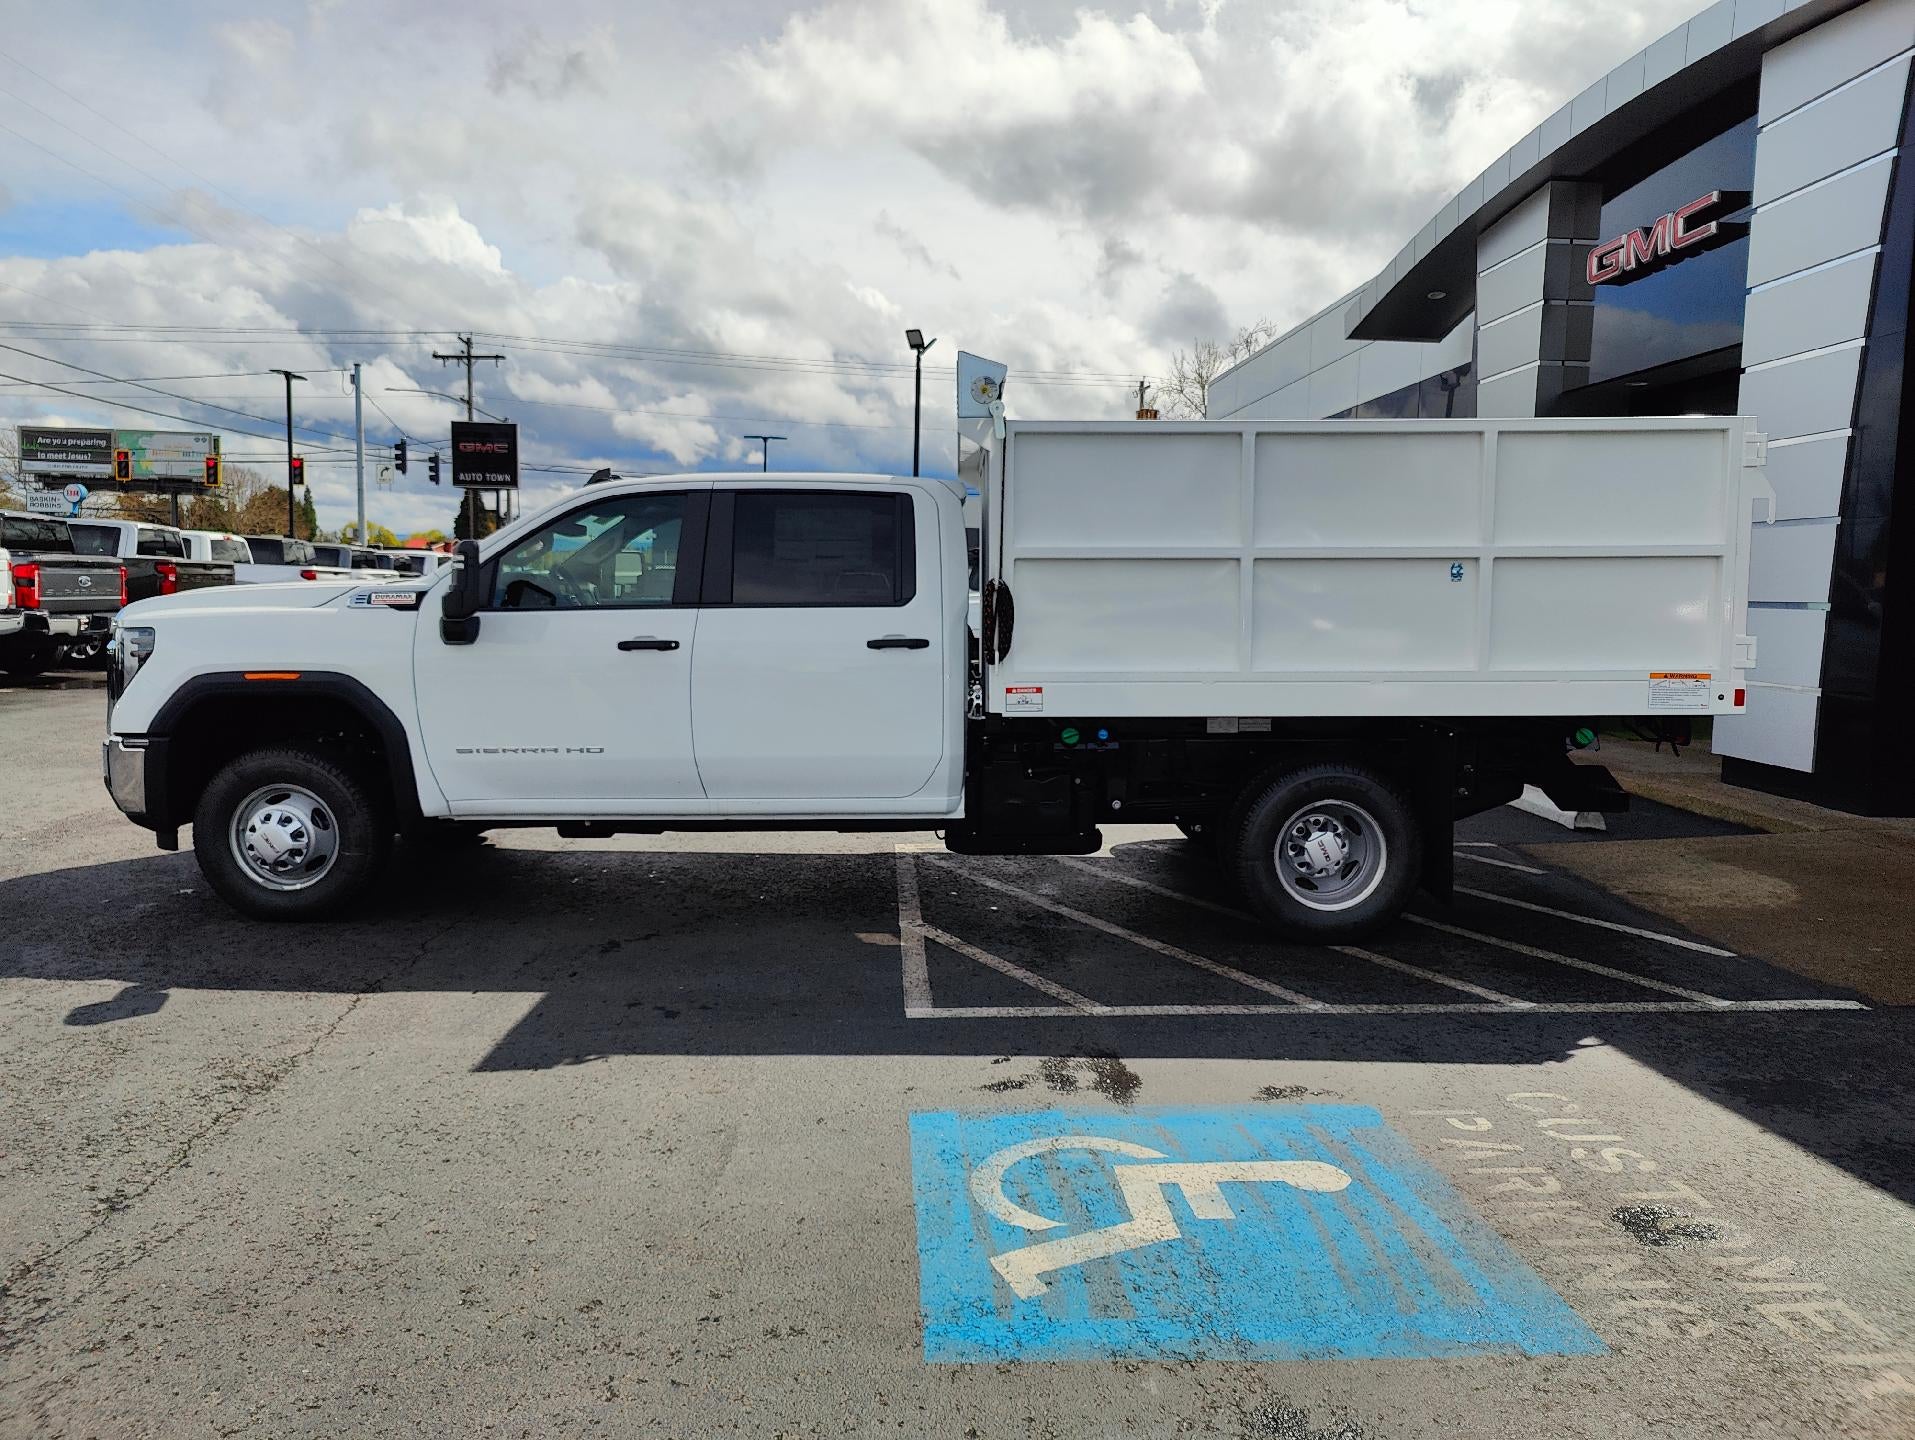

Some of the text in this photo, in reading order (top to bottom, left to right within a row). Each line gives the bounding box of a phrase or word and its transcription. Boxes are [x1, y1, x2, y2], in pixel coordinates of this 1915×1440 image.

[1586, 190, 1719, 285] GMC
[37, 436, 107, 447] Are you preparing
[459, 443, 509, 454] GMC
[37, 451, 92, 460] to meet Jesus?
[459, 472, 511, 482] AUTO TOWN
[1318, 840, 1331, 862] GMC
